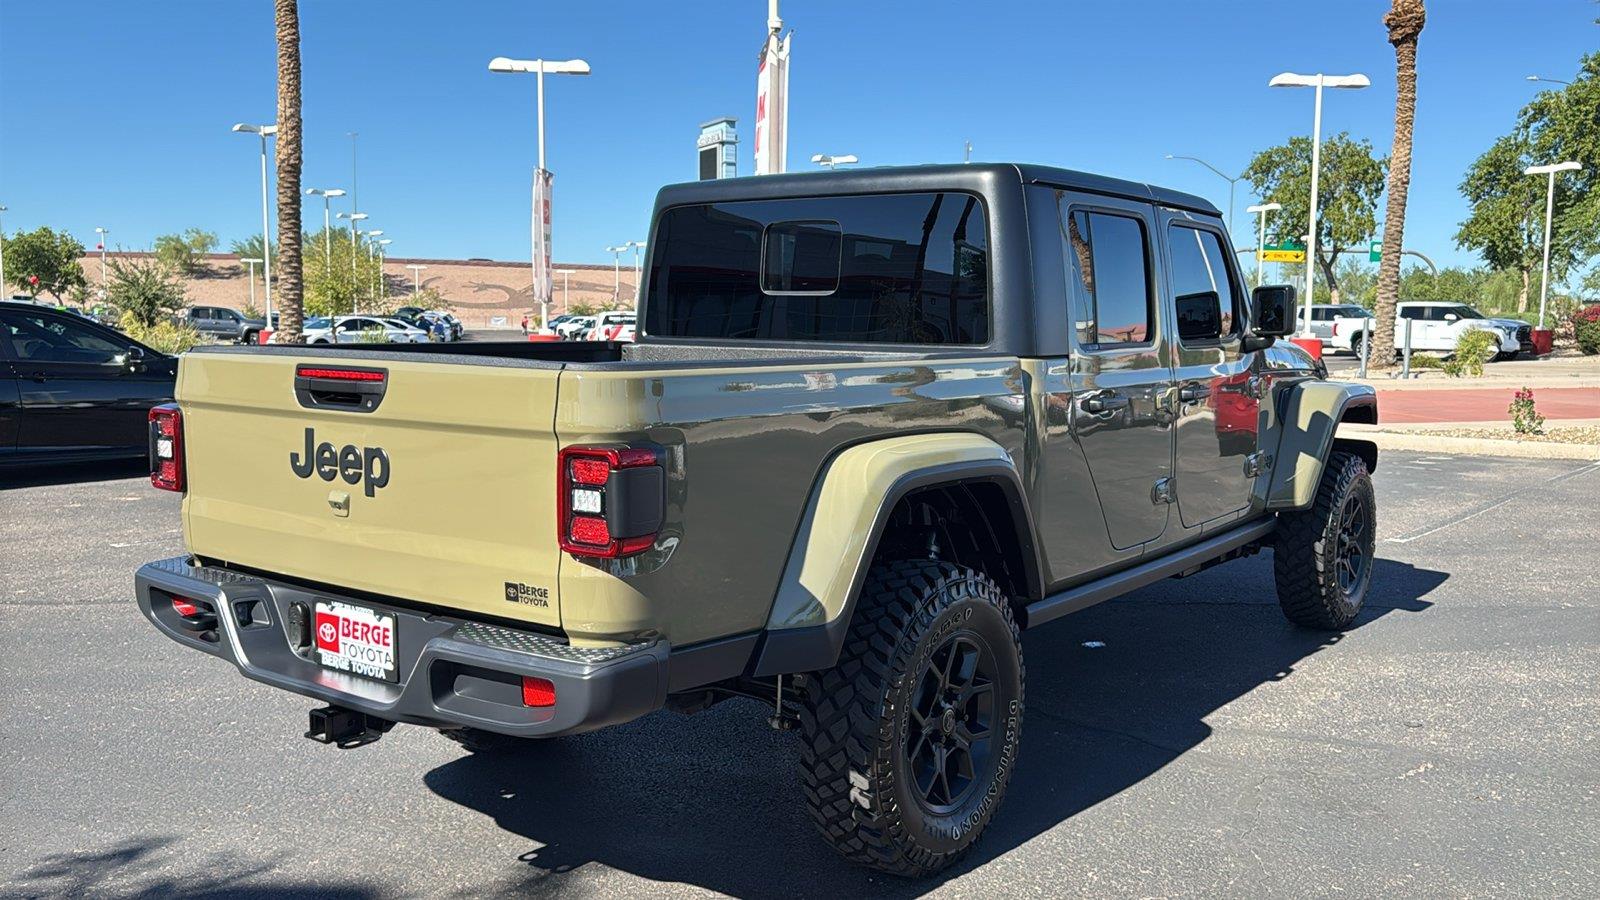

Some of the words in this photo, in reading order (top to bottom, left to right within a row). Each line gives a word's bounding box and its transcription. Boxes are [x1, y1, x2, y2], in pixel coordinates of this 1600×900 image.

[290, 428, 390, 498] Jeep
[519, 583, 549, 598] BERGE
[519, 596, 549, 608] TOYOTA
[341, 617, 390, 647] BERGE
[321, 653, 350, 671] BERGE
[351, 661, 386, 680] TOYOTA
[341, 642, 392, 664] TOYOTA
[961, 699, 1018, 834] DESTINATION
